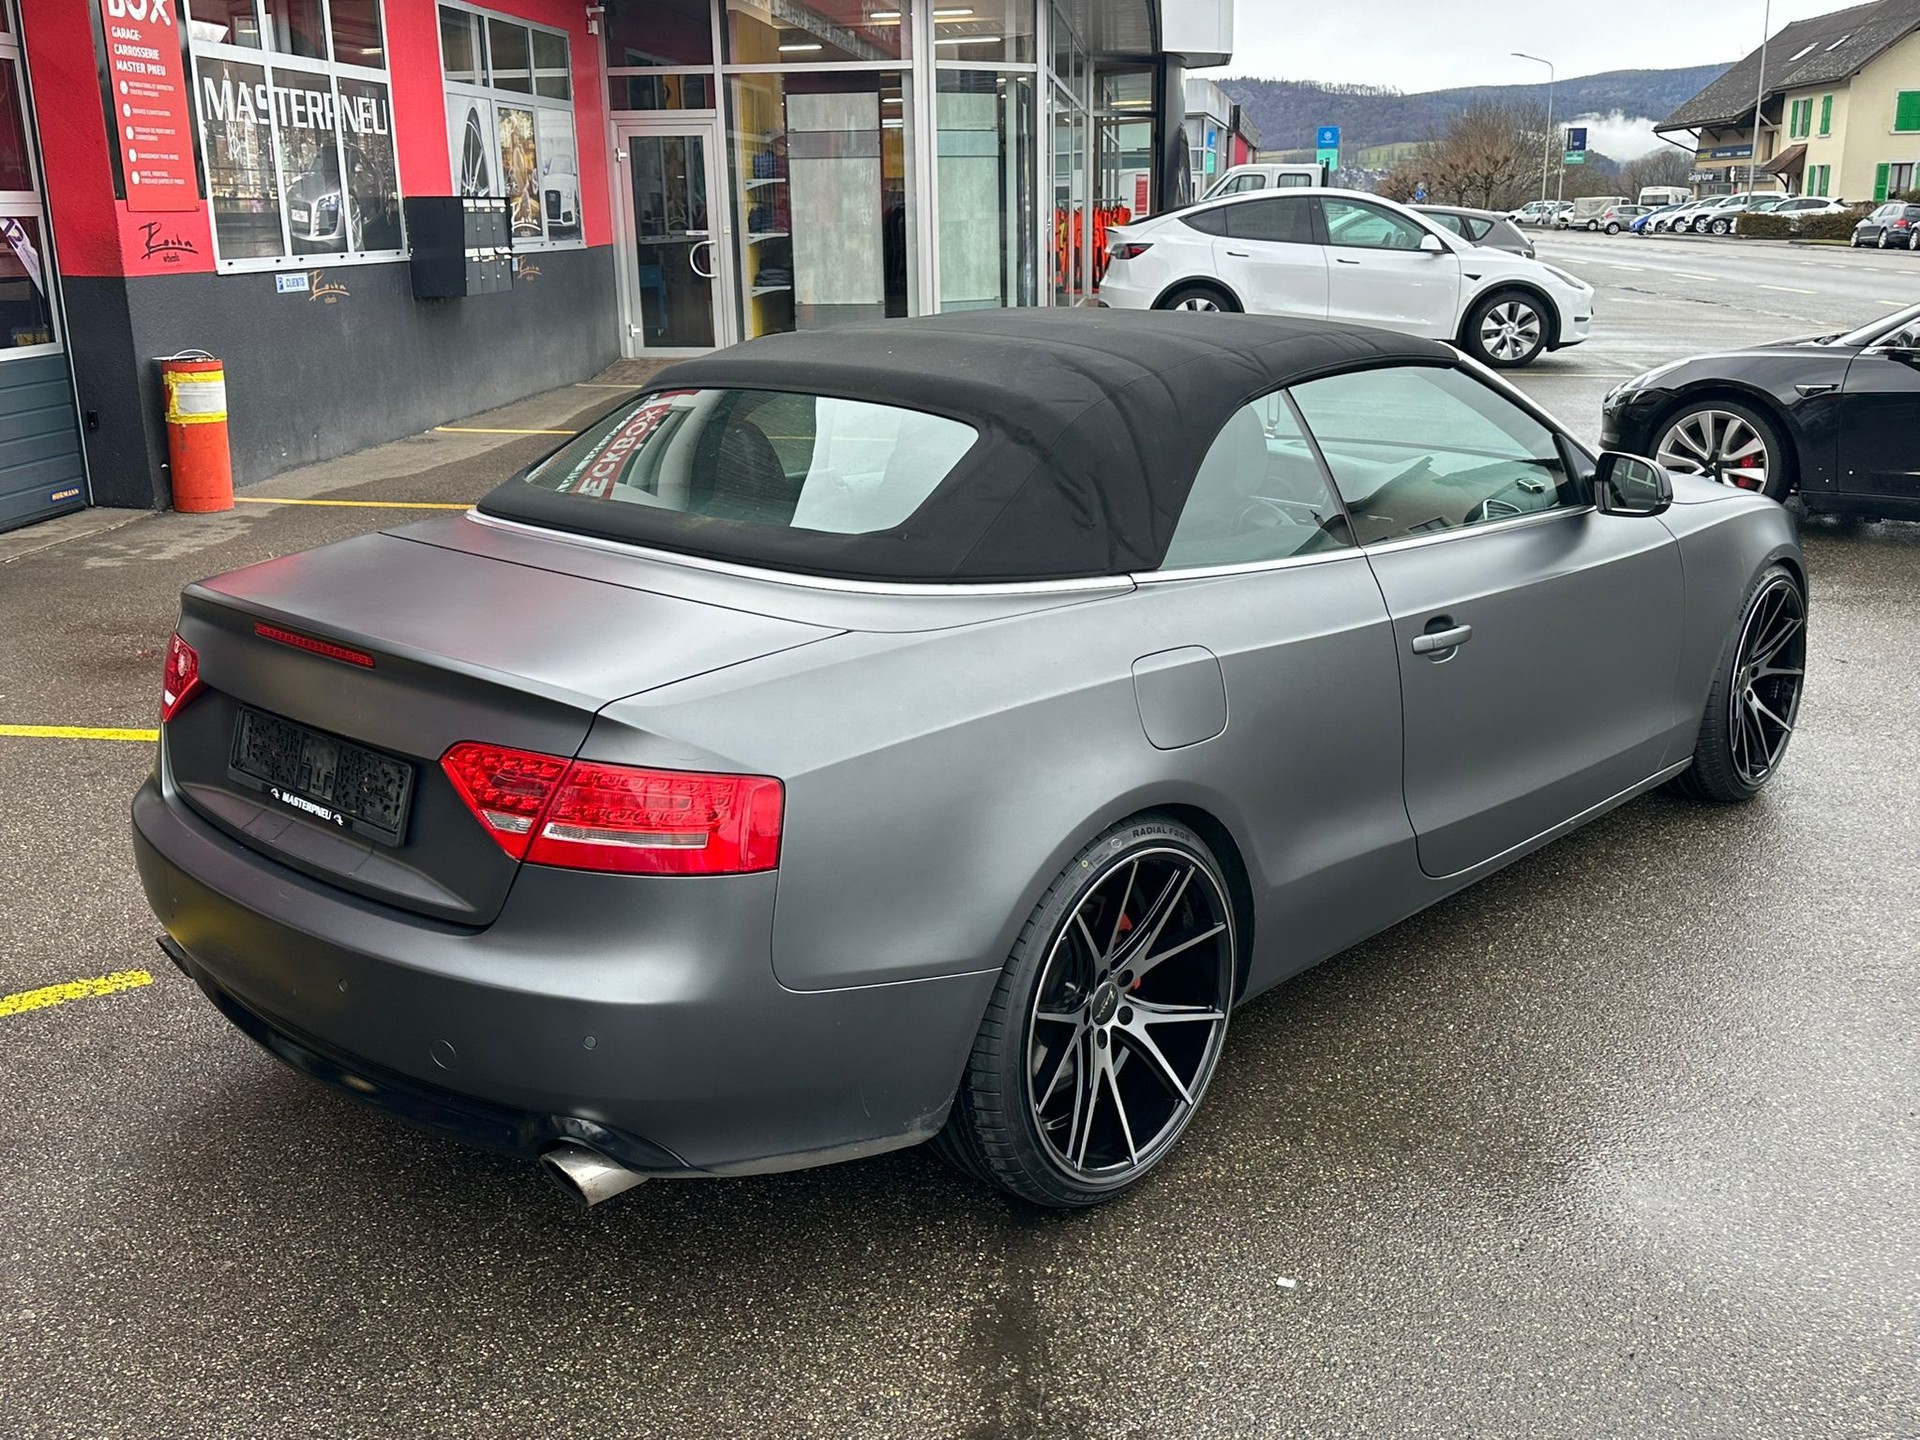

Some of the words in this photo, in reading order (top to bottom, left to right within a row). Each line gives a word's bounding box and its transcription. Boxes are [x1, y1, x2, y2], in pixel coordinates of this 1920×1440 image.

[113, 43, 160, 60] CARROSSERIE
[115, 60, 147, 74] MASTER
[147, 63, 166, 76] PNEU
[282, 792, 332, 820] MASTERPNEU
[1132, 826, 1168, 838] RADIAL
